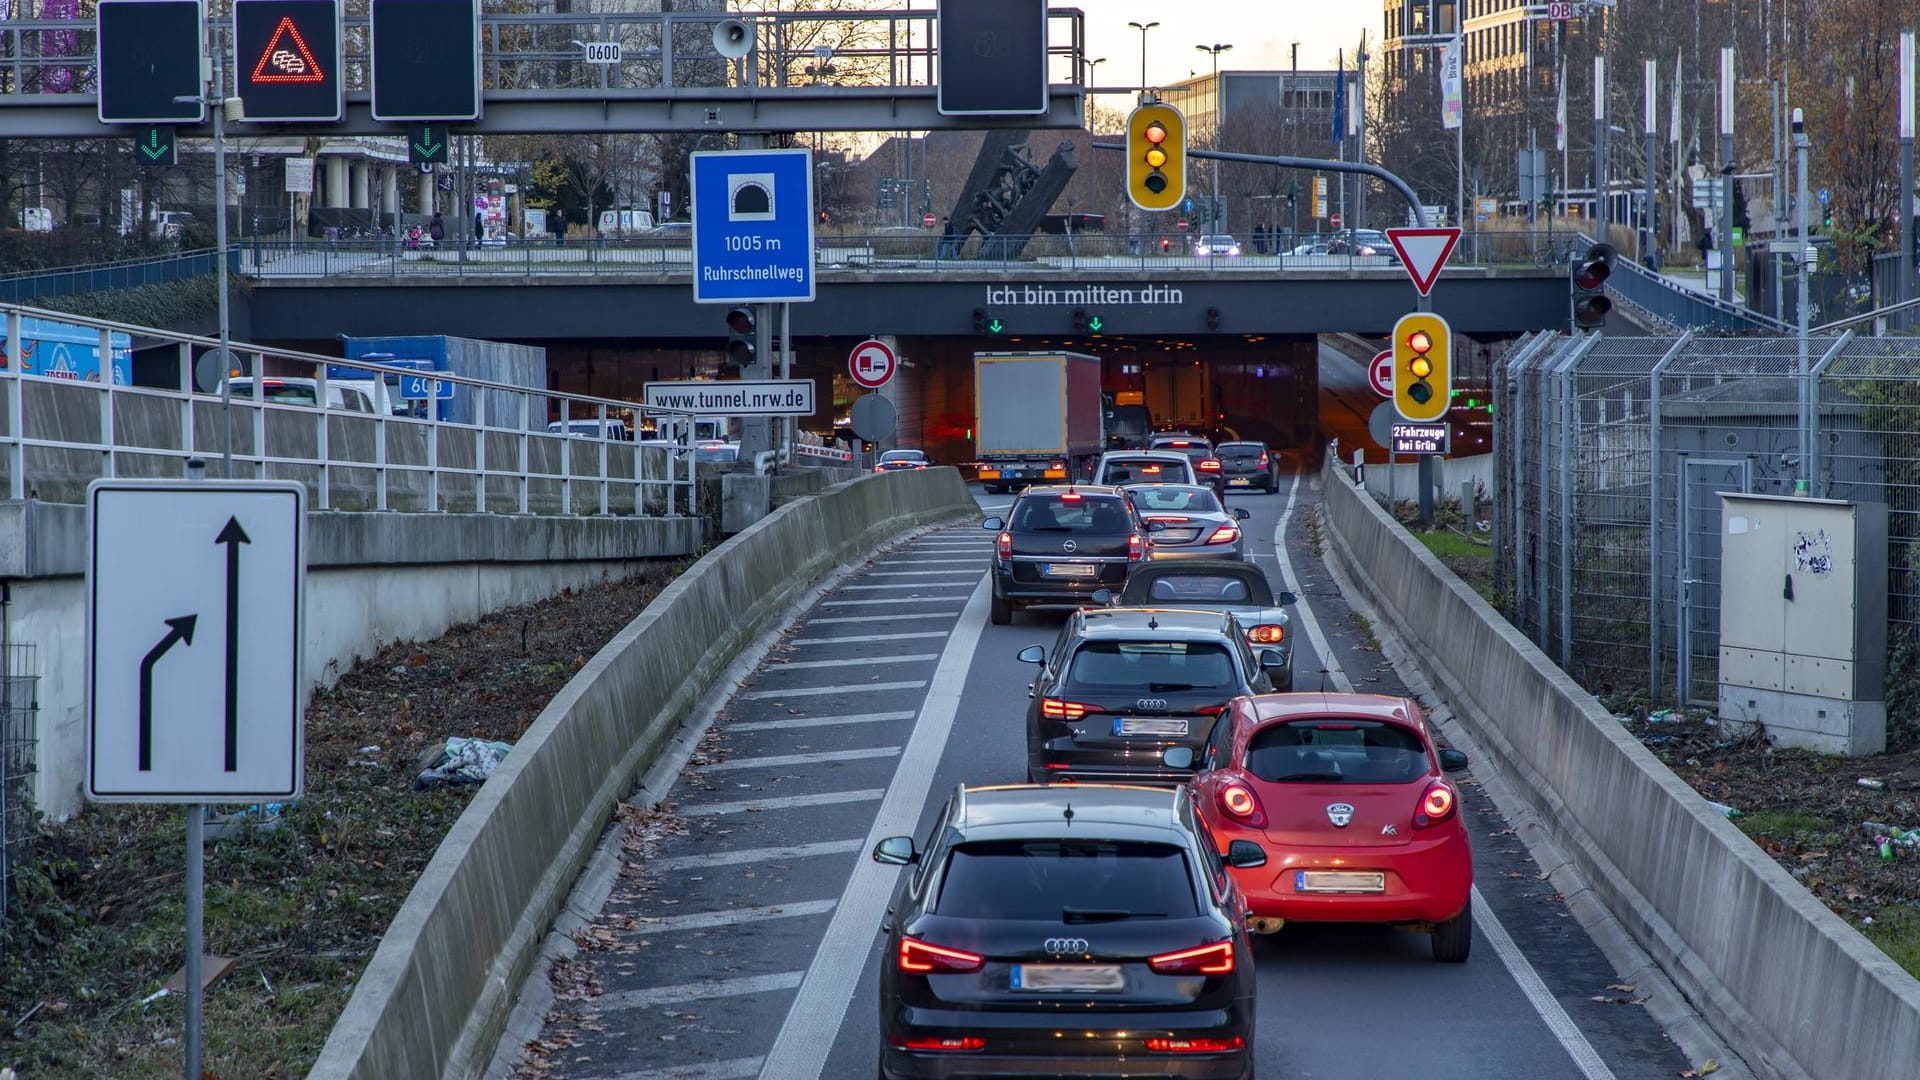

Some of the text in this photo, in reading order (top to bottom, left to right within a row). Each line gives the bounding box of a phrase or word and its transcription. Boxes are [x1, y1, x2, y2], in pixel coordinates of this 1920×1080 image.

[1551, 4, 1570, 18] DB
[589, 45, 619, 60] 0600
[725, 235, 781, 251] 1005 m
[703, 265, 804, 283] Ruhrschnellweg
[986, 284, 1184, 305] Ich bin mitten drin
[655, 389, 804, 409] www.tunnel.nrw.de
[1399, 440, 1413, 451] bei
